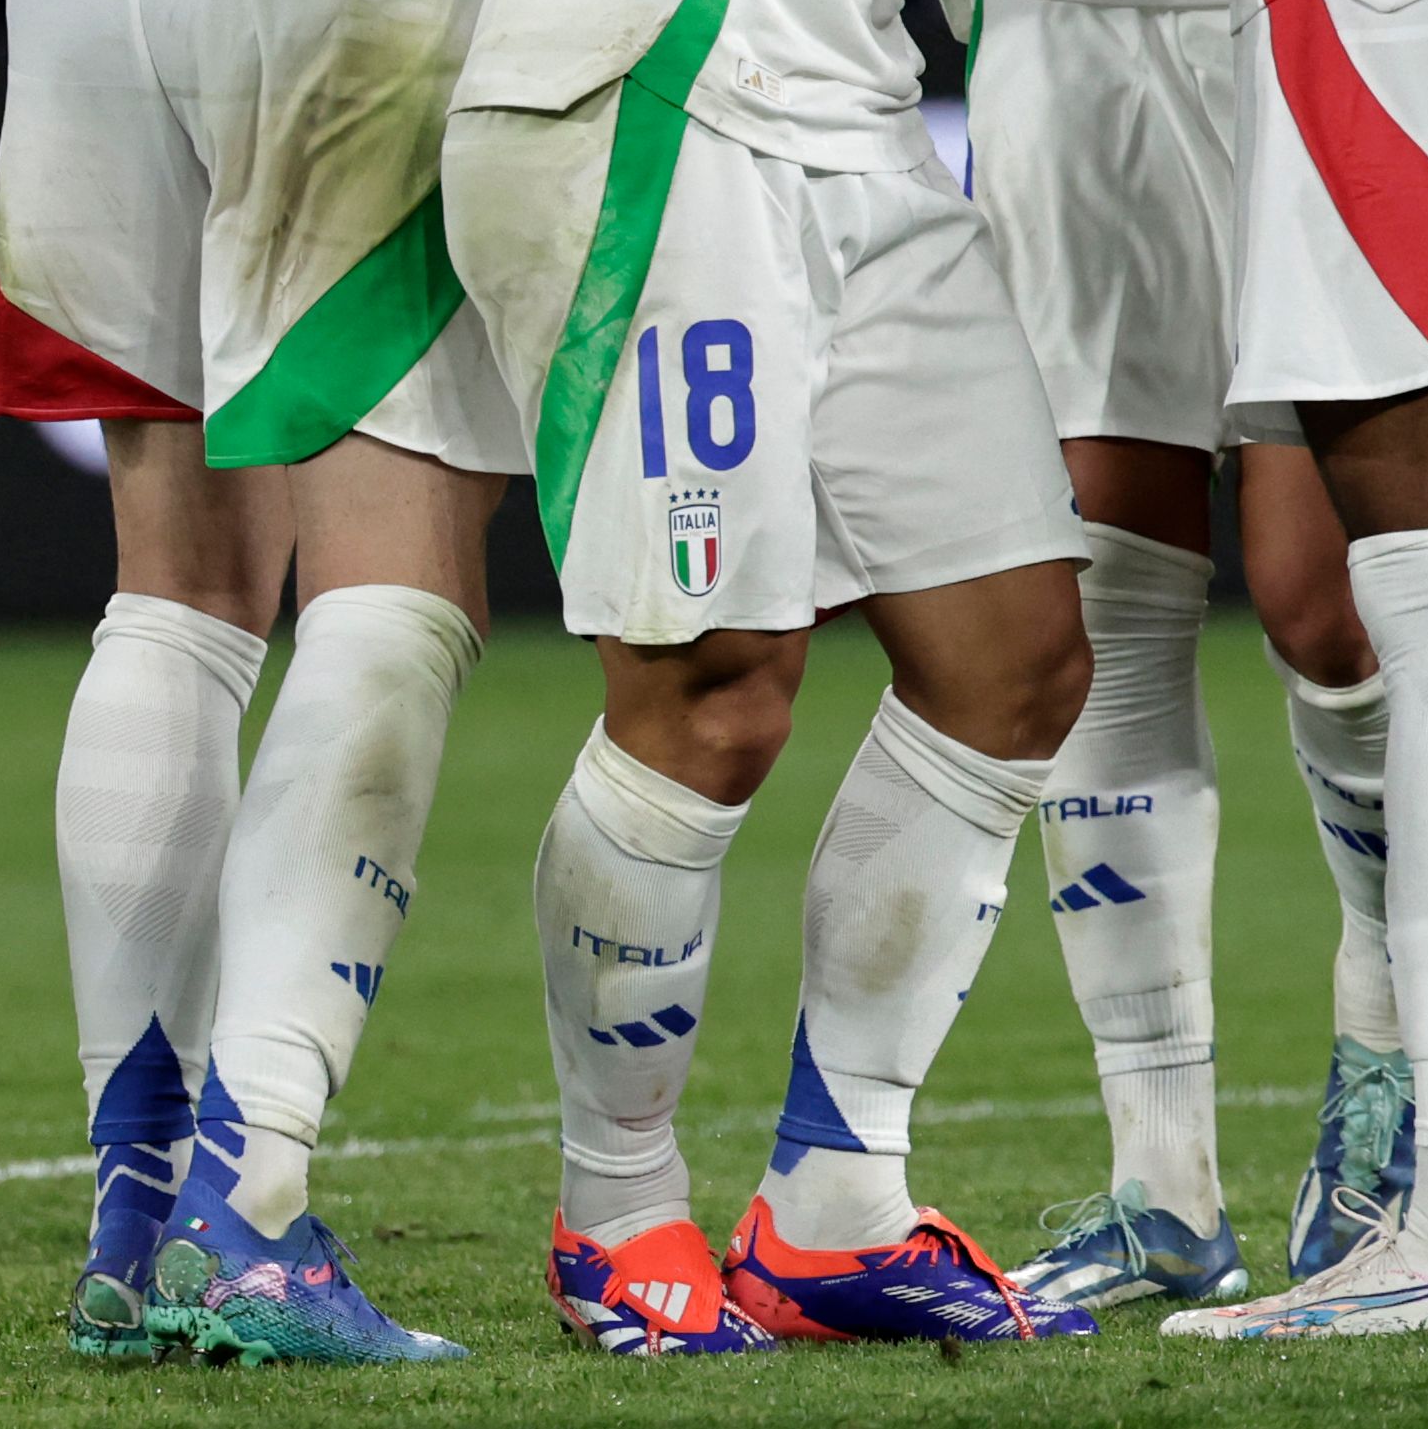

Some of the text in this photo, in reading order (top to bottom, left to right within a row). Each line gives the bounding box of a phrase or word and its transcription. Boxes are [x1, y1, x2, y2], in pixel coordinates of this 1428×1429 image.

[638, 319, 756, 479] 18
[673, 512, 717, 531] ITALIA
[573, 925, 703, 967] ITALIA
